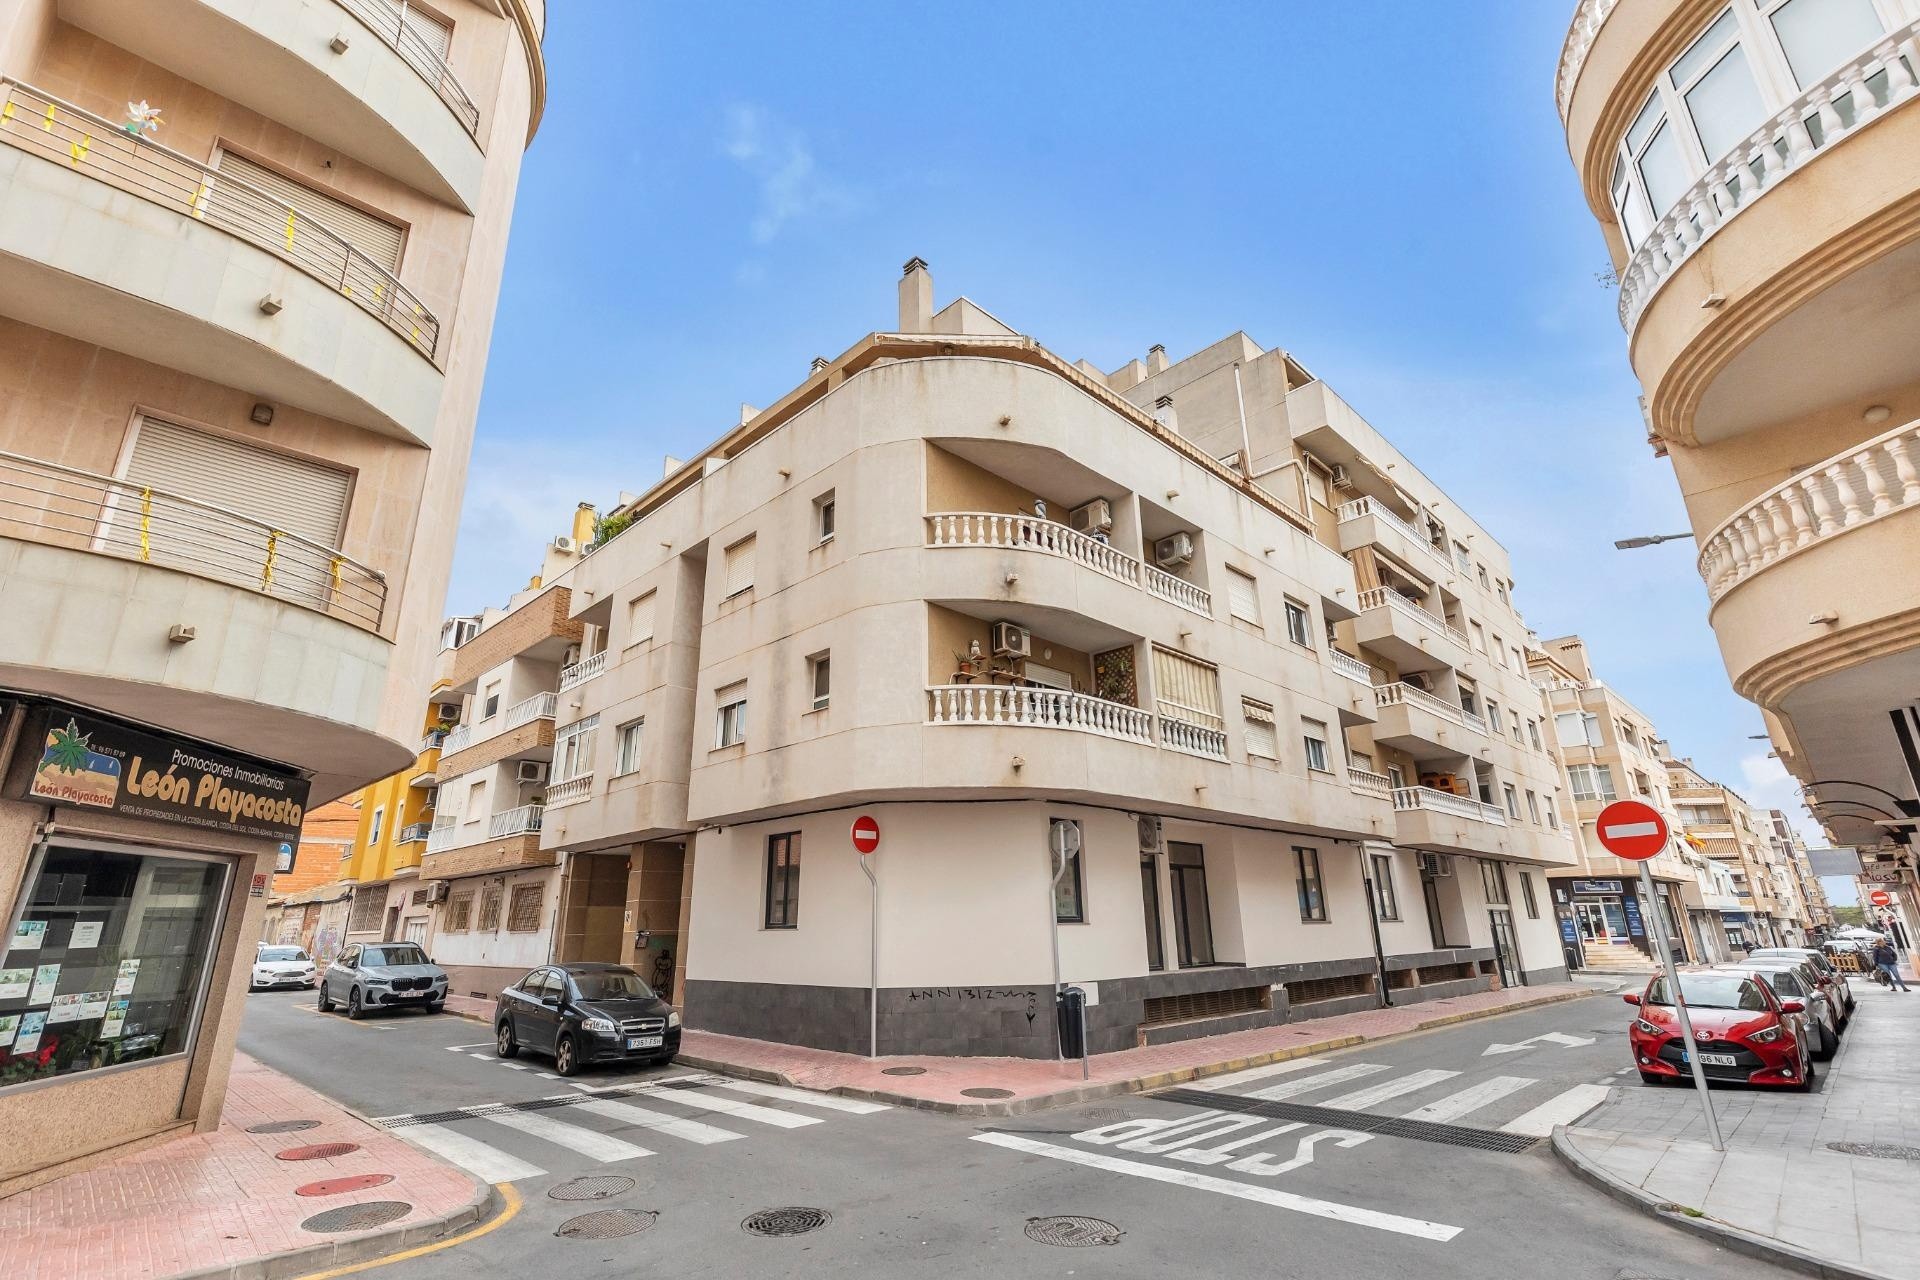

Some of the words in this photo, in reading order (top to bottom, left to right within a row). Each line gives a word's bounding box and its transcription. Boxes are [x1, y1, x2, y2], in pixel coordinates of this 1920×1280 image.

[172, 749, 233, 778] Promociones
[235, 766, 285, 791] Inmobiliarias
[34, 781, 59, 797] León
[62, 785, 113, 806] Playacosta
[126, 755, 190, 805] León
[194, 773, 302, 827] Playacosta
[120, 804, 134, 815] VENTA
[143, 808, 174, 820] PROPIEDADES
[1714, 1056, 1732, 1064] NLG
[1070, 1109, 1376, 1176] STOP
